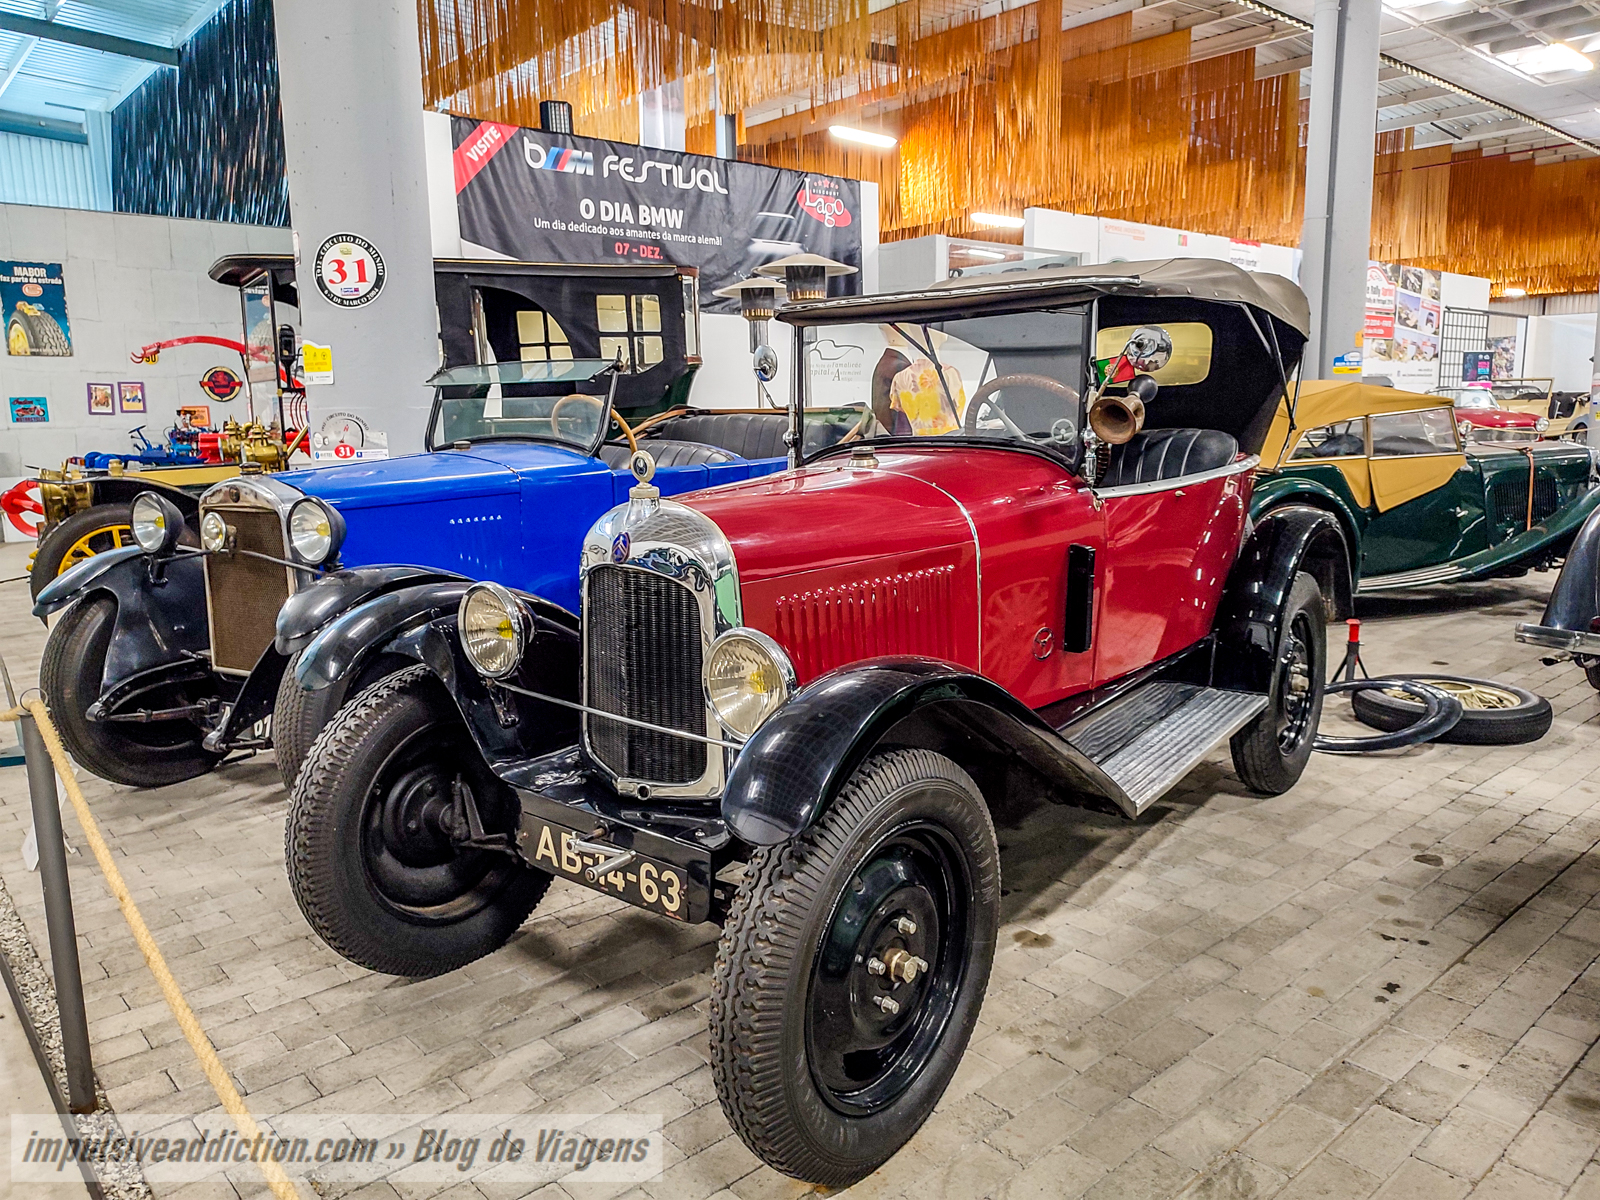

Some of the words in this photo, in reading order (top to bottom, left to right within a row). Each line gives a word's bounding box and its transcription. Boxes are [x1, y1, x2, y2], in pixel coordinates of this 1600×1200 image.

[466, 126, 501, 162] VISITE
[580, 198, 596, 220] O
[600, 200, 635, 225] DIA
[638, 204, 684, 230] BMW
[803, 177, 845, 228] Lago
[533, 217, 551, 229] Um
[552, 219, 566, 231] dia
[568, 221, 608, 235] dedicado
[609, 226, 624, 237] aos
[625, 228, 661, 240] amantes
[662, 230, 672, 241] da
[673, 233, 696, 244] marca
[697, 234, 723, 246] alemã!
[320, 235, 354, 256] CIRCUITO
[355, 238, 368, 249] DO
[368, 246, 385, 276] MINHO
[614, 242, 630, 255] 07
[640, 245, 664, 260] DEZ.
[11, 275, 28, 284] parte
[38, 277, 63, 285] estrada
[13, 266, 47, 278] MABOR
[327, 258, 371, 285] 31
[333, 296, 343, 305] DE
[326, 411, 347, 421] CIRCUITO
[355, 415, 369, 431] MINHO
[338, 446, 352, 458] 31
